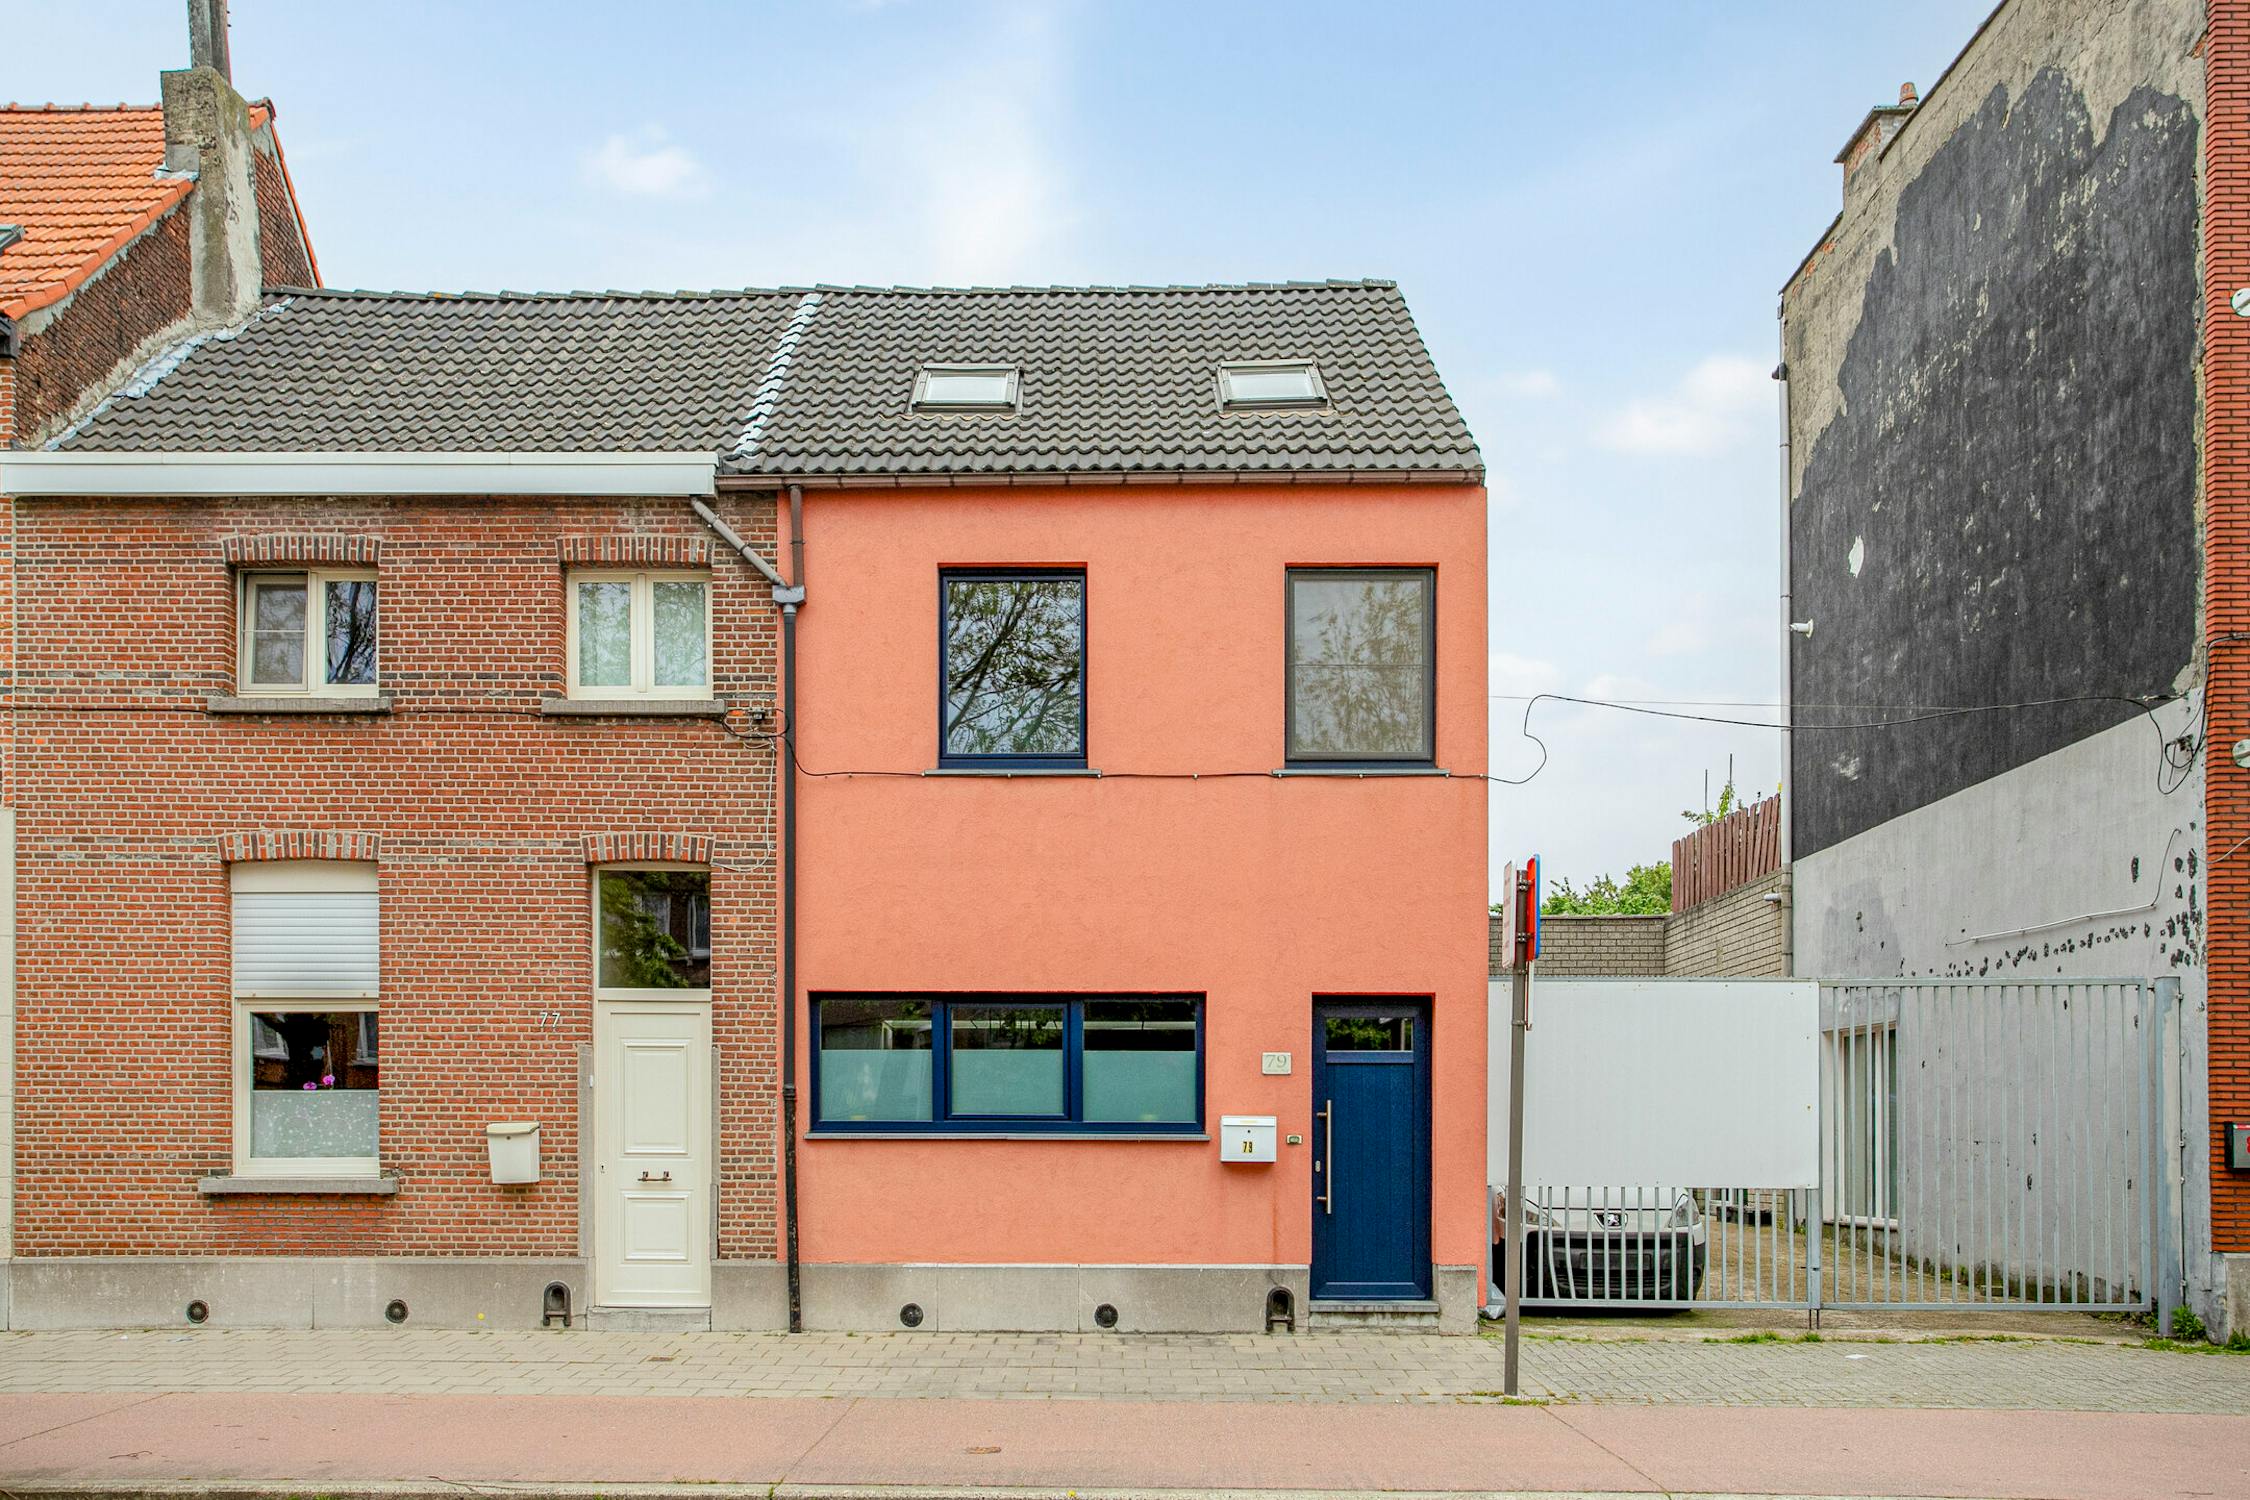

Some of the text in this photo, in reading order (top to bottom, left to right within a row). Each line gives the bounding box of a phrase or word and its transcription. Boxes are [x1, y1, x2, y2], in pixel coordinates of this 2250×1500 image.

[540, 1012, 560, 1028] 77
[1265, 1054, 1287, 1068] 79
[1243, 1141, 1253, 1153] 79
